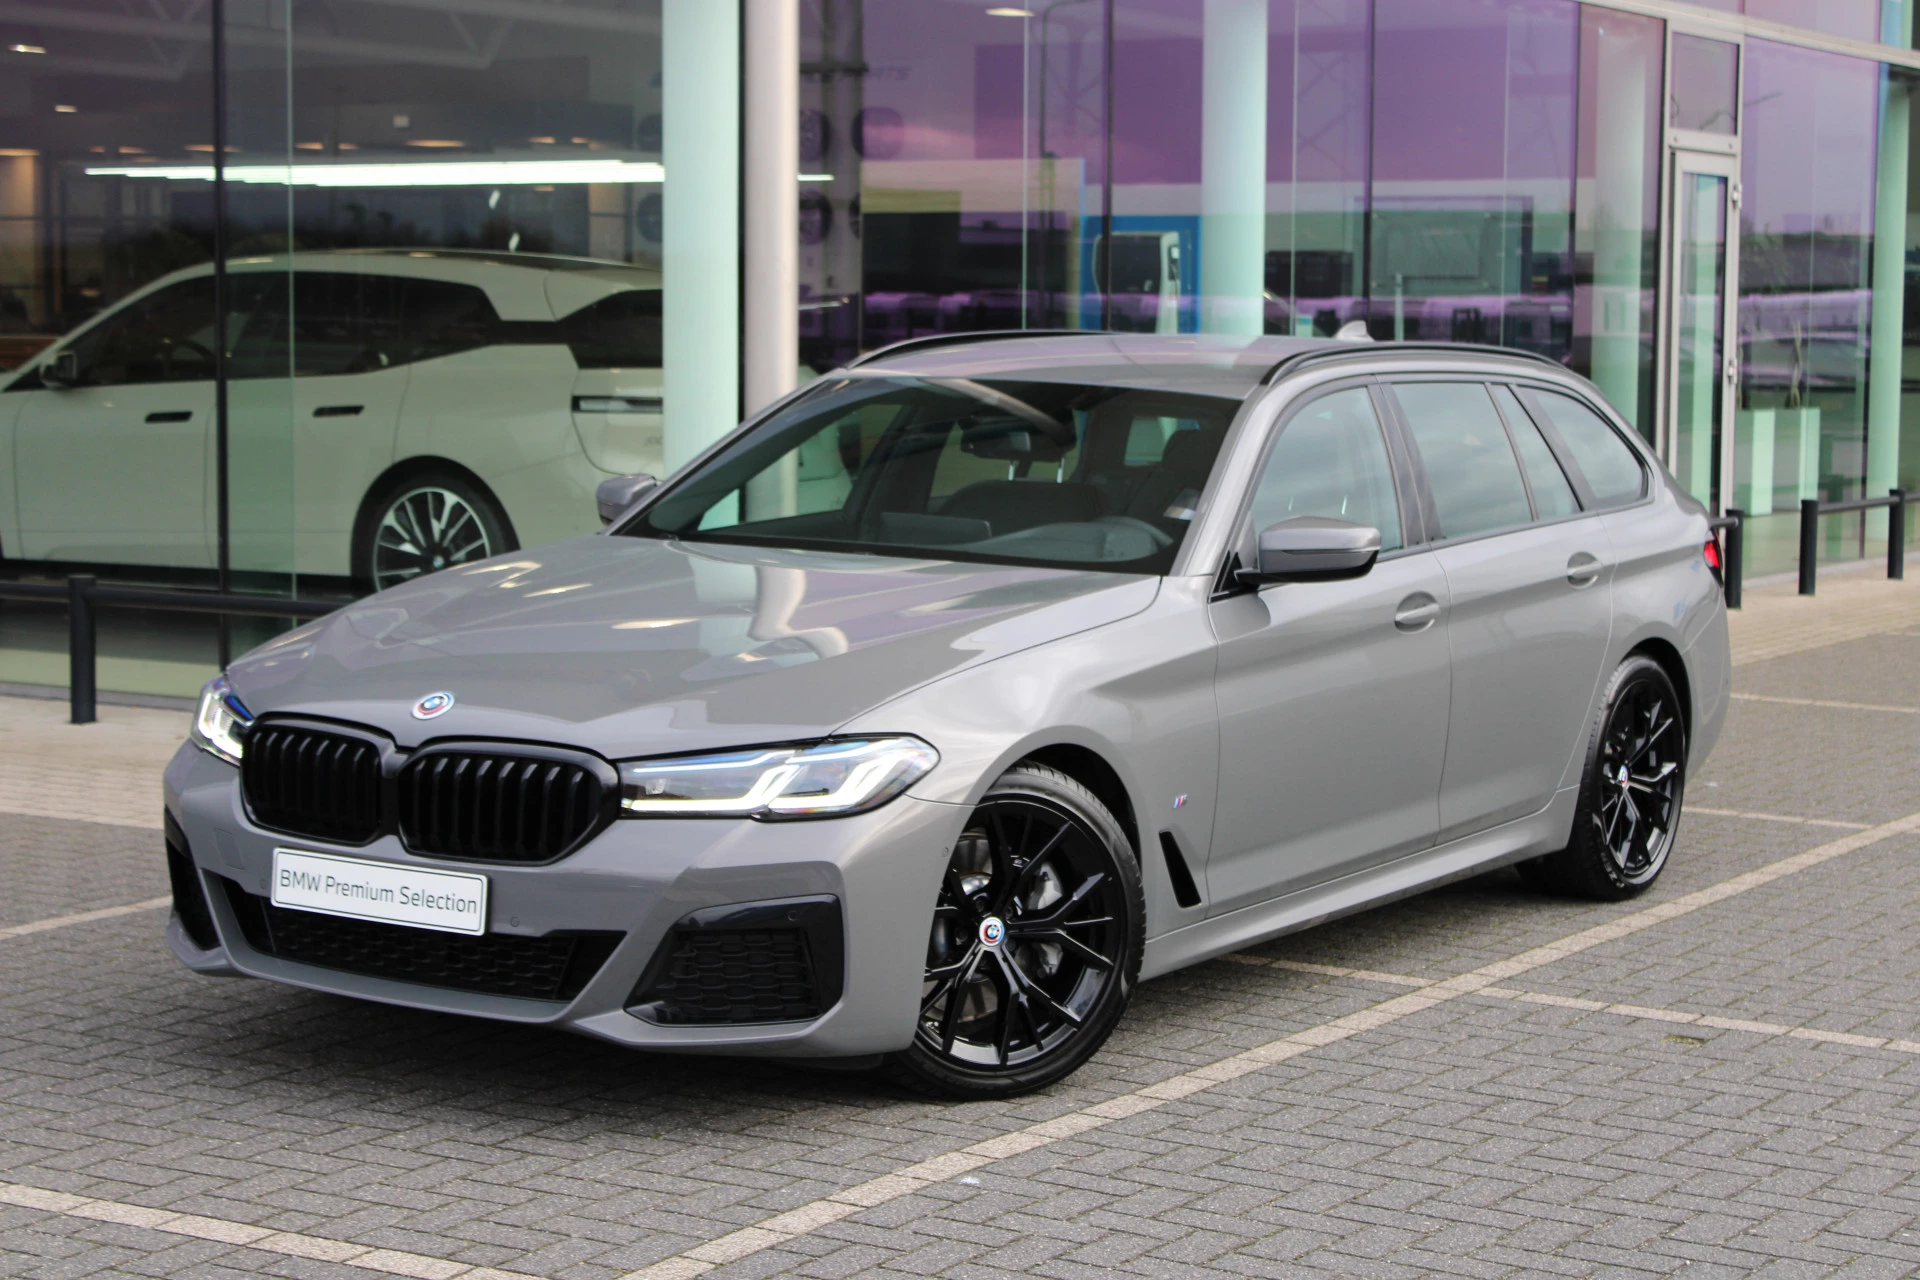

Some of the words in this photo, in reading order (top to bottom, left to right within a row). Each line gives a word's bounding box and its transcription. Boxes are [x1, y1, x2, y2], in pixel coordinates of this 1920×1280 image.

[280, 869, 321, 892] BMW
[325, 875, 394, 903] Premium
[399, 886, 477, 914] Selection
